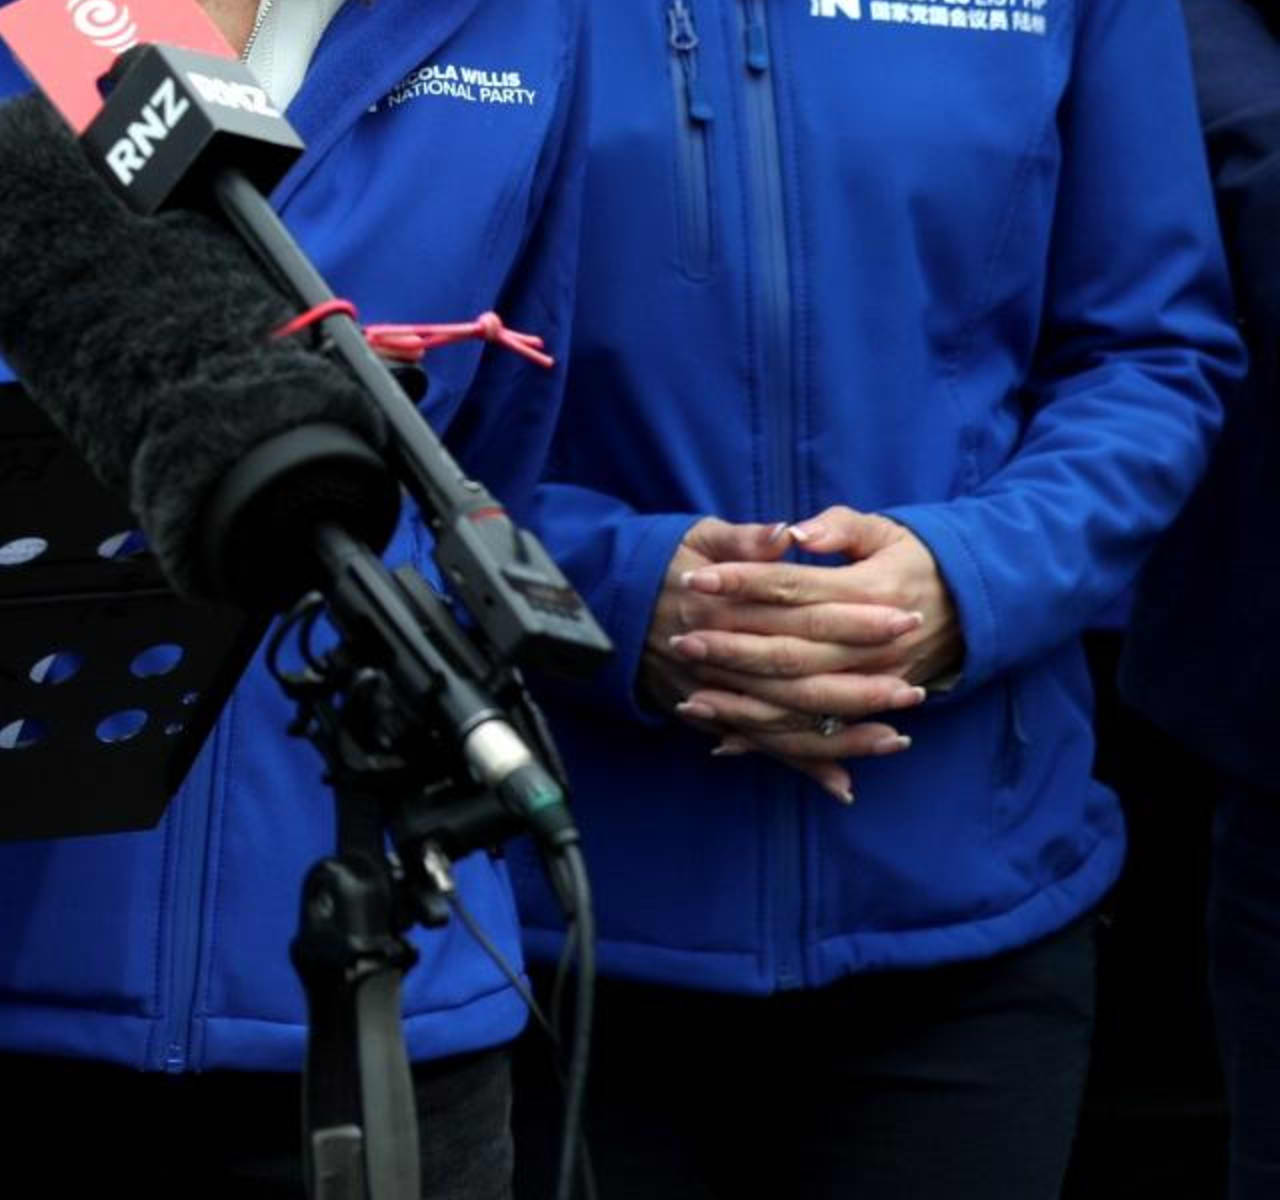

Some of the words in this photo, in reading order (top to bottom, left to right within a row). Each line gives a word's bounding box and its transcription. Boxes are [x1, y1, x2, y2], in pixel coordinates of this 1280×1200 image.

[460, 66, 521, 88] WILLIS
[388, 79, 476, 106] NATIONAL
[480, 87, 537, 106] PARTY
[105, 76, 191, 187] RNZ
